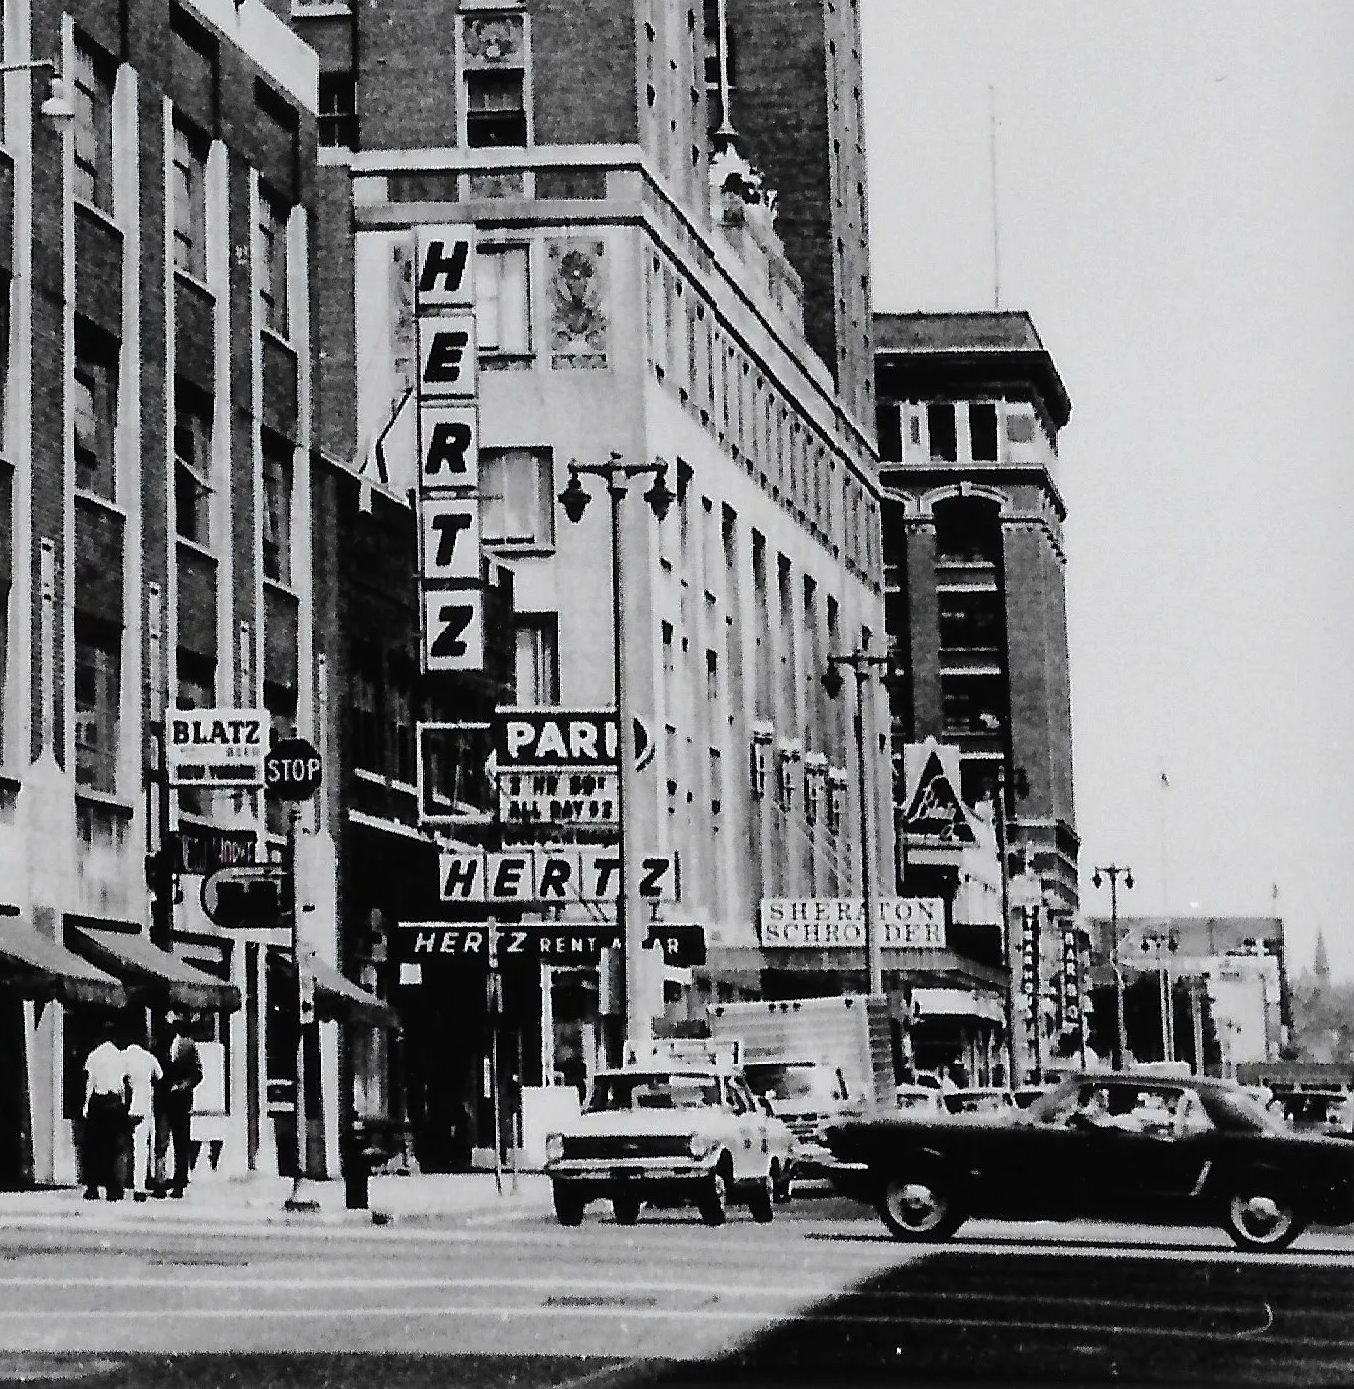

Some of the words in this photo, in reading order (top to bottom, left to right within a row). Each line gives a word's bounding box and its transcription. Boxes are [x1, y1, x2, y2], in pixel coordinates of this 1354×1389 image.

[419, 241, 474, 659] HERTZ
[172, 720, 261, 746] BLATZ
[267, 759, 320, 782] STOP
[443, 858, 670, 899] HERTZ
[540, 936, 596, 953] RENT
[766, 923, 941, 942] SCHRODER
